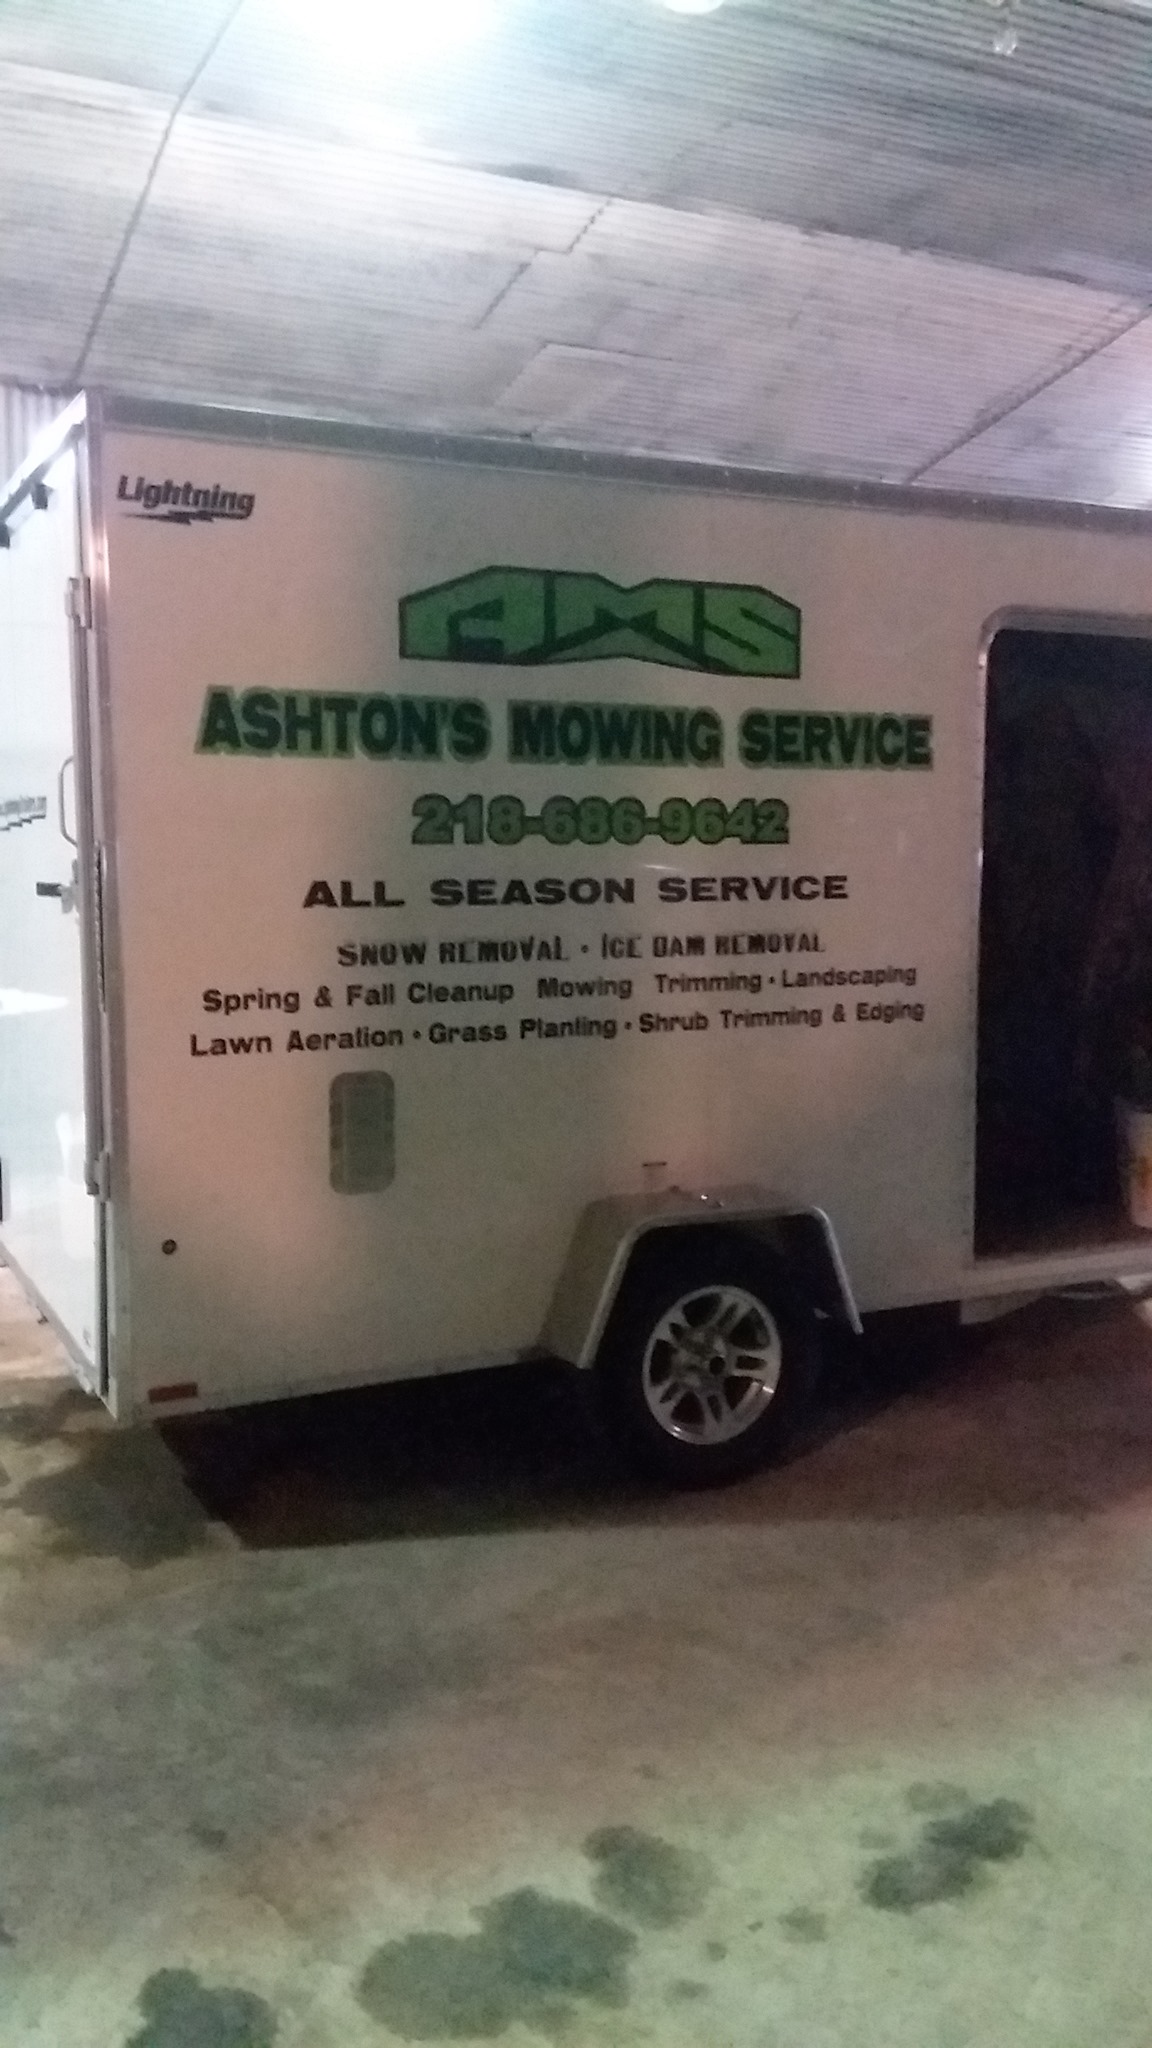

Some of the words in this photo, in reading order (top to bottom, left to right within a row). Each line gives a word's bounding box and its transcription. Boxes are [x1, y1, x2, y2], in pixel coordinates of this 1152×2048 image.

[117, 475, 255, 520] Lightning
[399, 565, 801, 679] AMS
[195, 685, 492, 762] ASHTON'S
[507, 702, 725, 767] MOWING
[739, 708, 934, 771] SERVICE
[411, 793, 790, 846] 218-686-9642
[303, 880, 405, 908] ALL
[429, 877, 635, 907] SEASON
[657, 874, 849, 902] SERVICE
[337, 940, 426, 967] SNOW
[438, 933, 570, 965] REMOVAL
[601, 932, 643, 960] ICE
[653, 934, 705, 958] DAM
[715, 931, 826, 957] REMOVAL
[202, 987, 300, 1015] Spring
[314, 985, 332, 1008] &
[346, 982, 395, 1006] Fall
[407, 980, 515, 1005] Cleanup
[537, 976, 633, 1000] Mowing
[655, 971, 763, 994] Trimming
[782, 965, 917, 988] Landscaping
[190, 1033, 272, 1057] Lawn
[286, 1026, 403, 1052] Aeration
[428, 1021, 508, 1045] Grass
[519, 1016, 618, 1040] Planting
[638, 1012, 709, 1034] Shrub
[720, 1006, 823, 1028] Trimming
[831, 1002, 847, 1023] &
[856, 1000, 926, 1024] Edging
